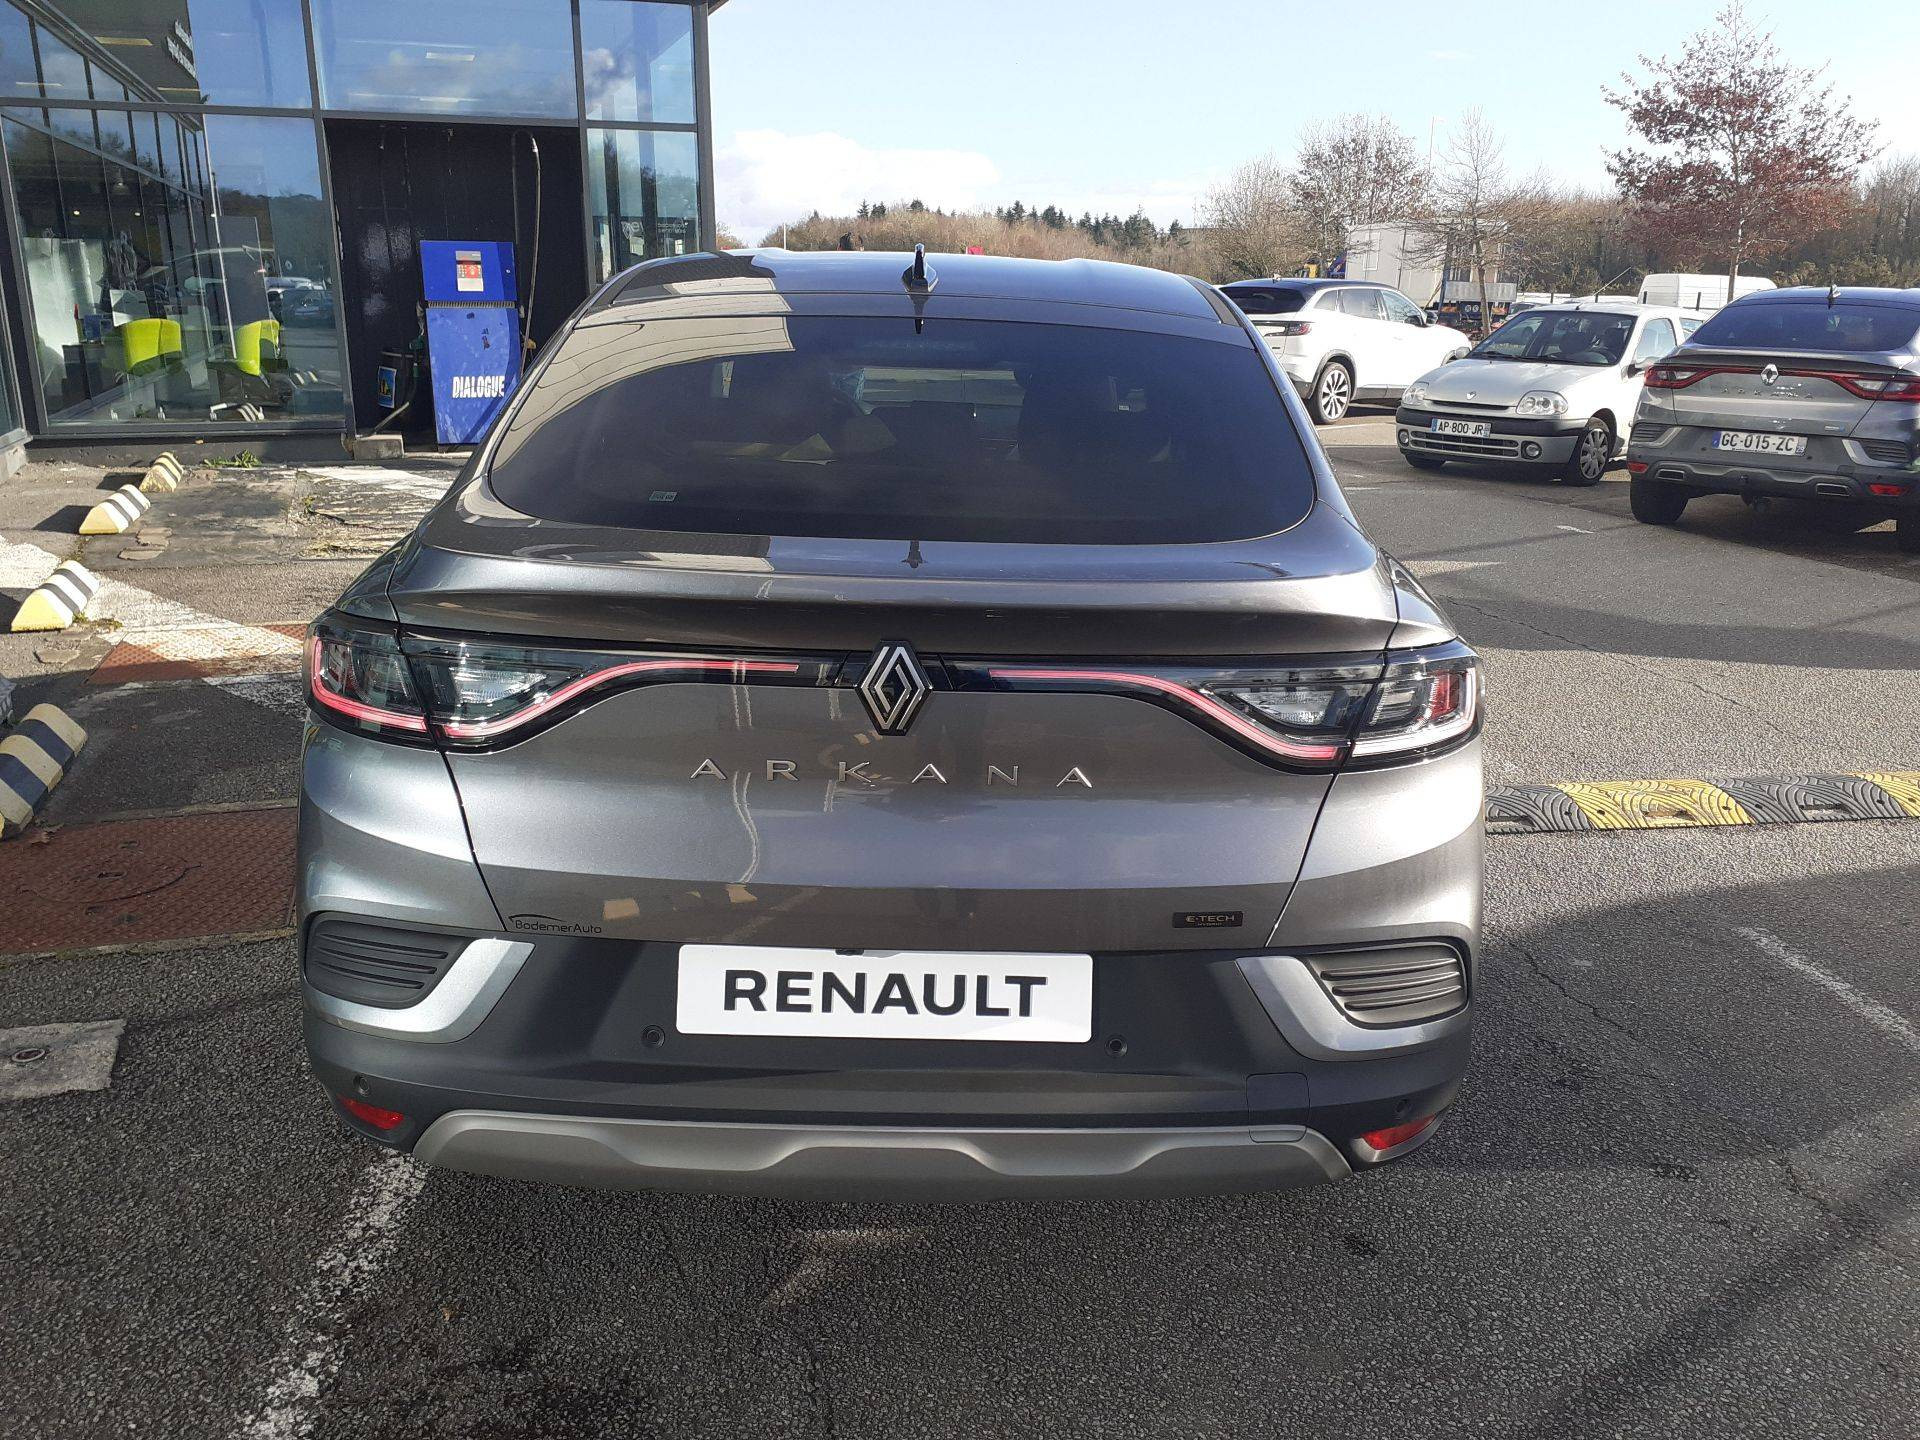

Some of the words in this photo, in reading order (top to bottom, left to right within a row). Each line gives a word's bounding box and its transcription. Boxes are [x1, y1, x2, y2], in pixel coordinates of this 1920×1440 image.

[452, 375, 505, 398] DIALOGUE
[1721, 433, 1795, 451] GC-015-ZC
[690, 758, 1093, 789] ARKANA
[515, 919, 602, 934] BodemerAuto
[723, 969, 1049, 1017] RENAULT
